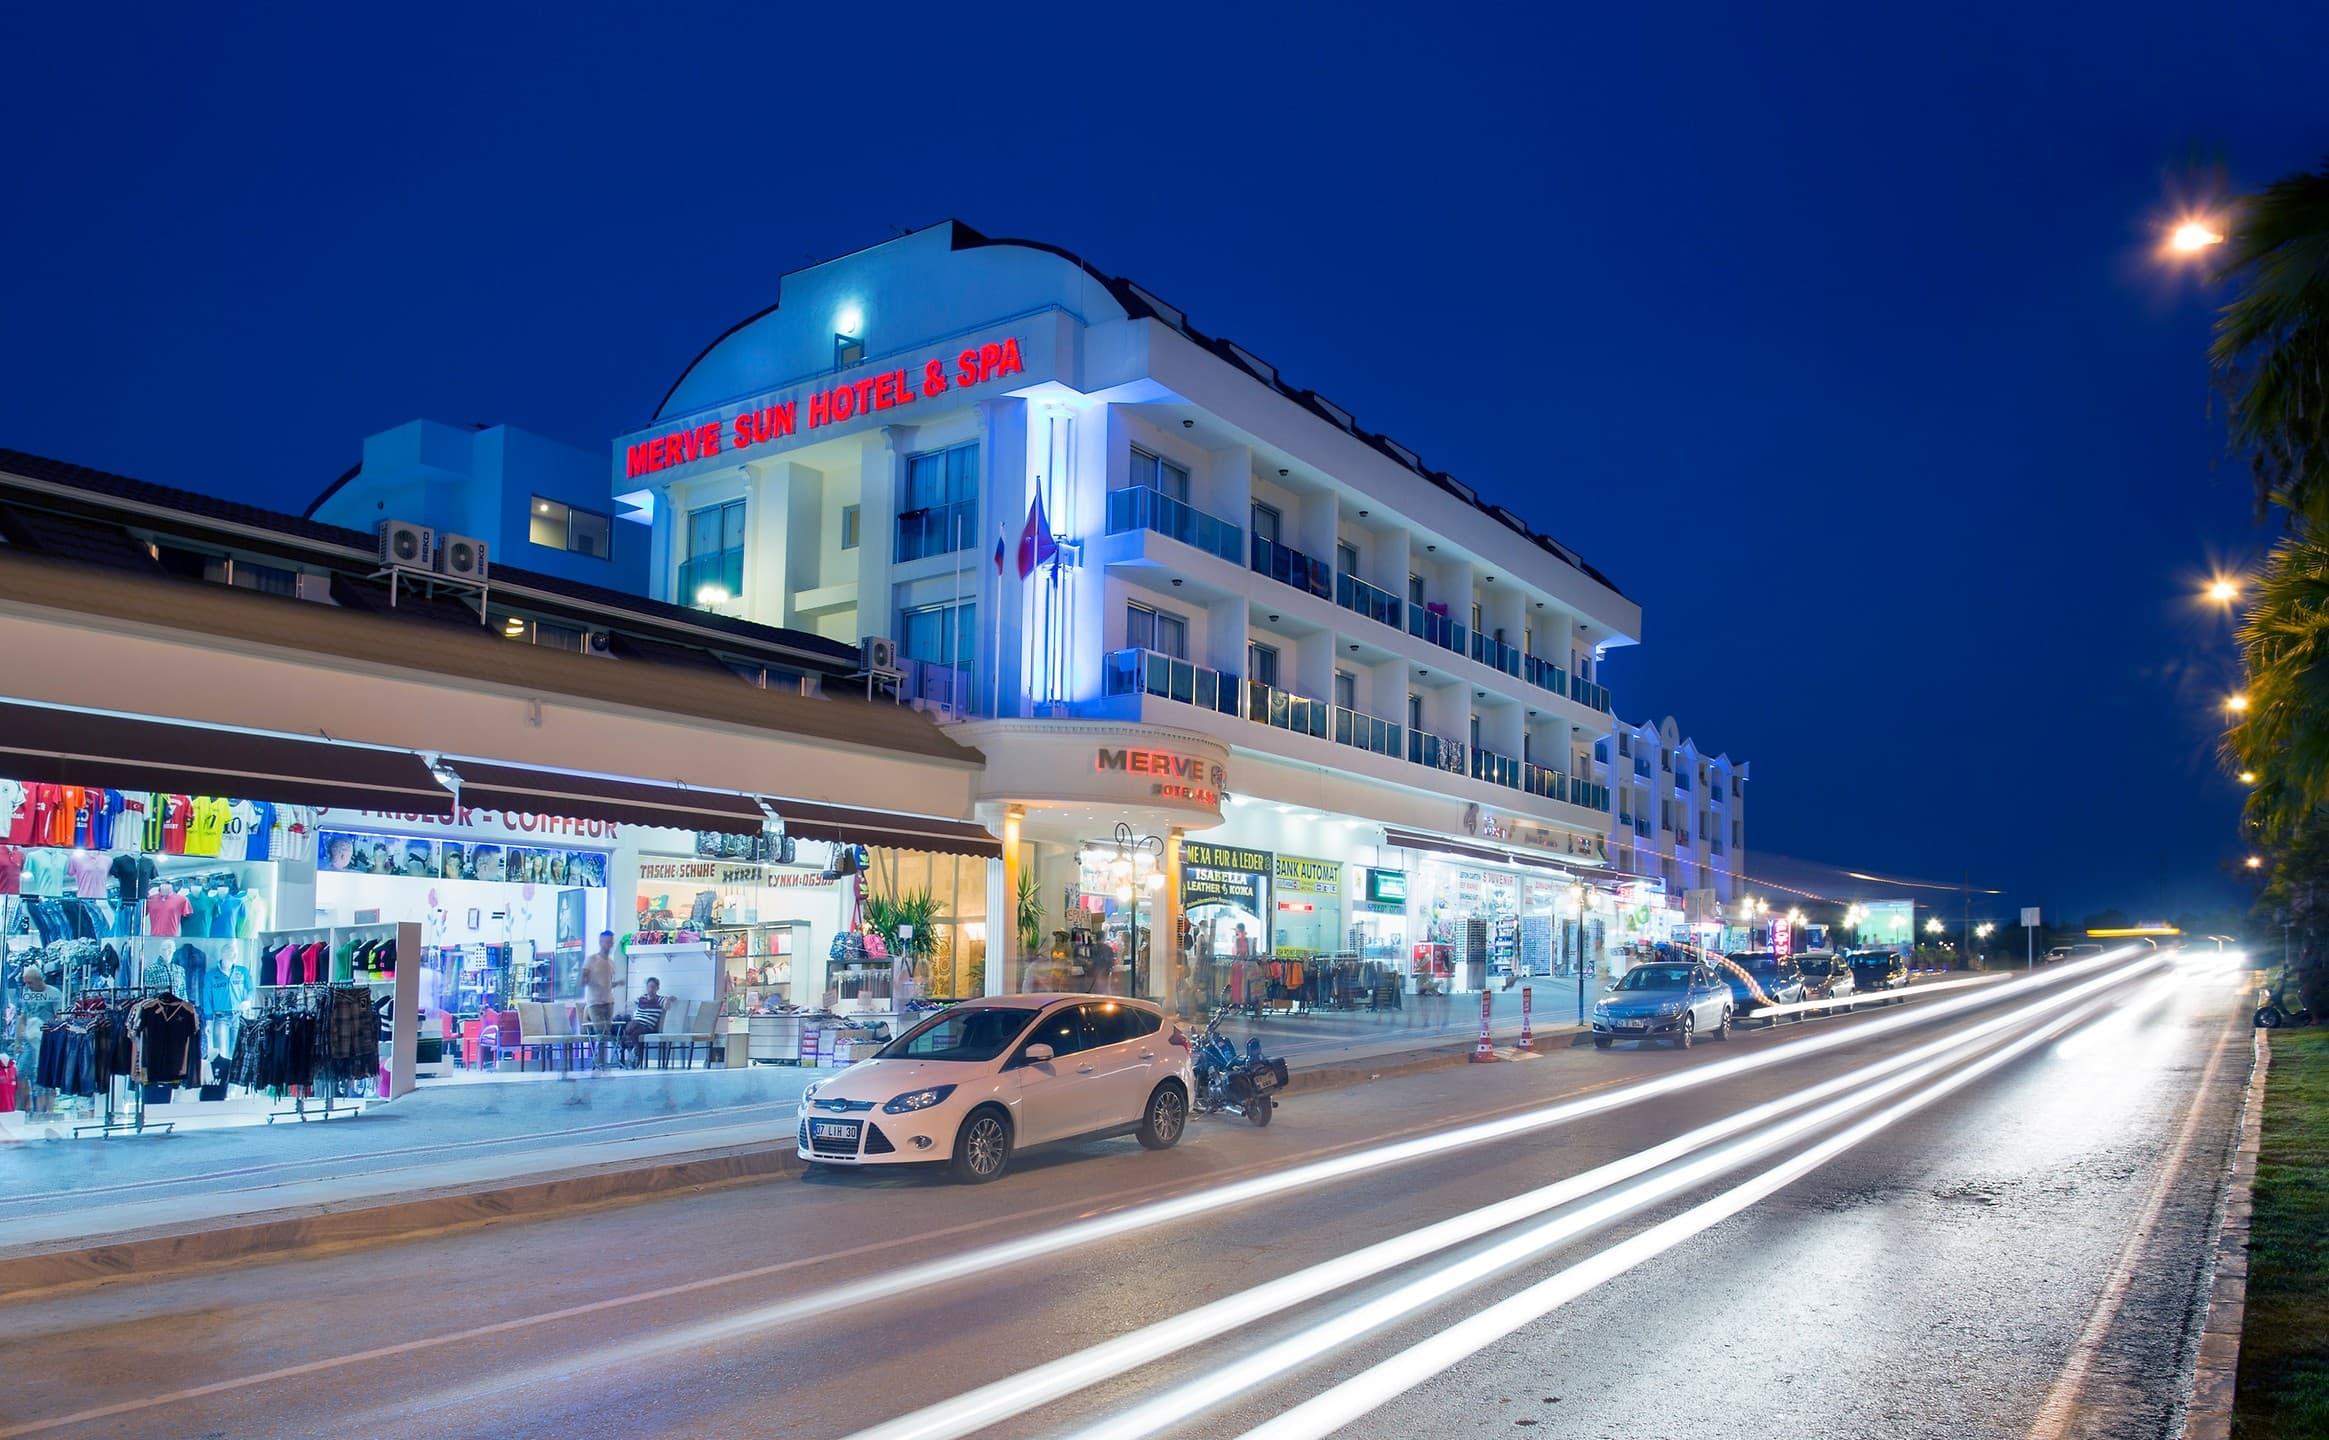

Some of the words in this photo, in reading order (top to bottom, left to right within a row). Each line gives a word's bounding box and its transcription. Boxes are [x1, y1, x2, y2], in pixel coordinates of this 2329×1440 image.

[625, 420, 722, 479] MERVE
[733, 400, 799, 450] SUN
[808, 368, 914, 430] HOTEL
[922, 358, 947, 397] &
[955, 336, 1024, 389] SPA
[1097, 748, 1205, 782] MERVE
[502, 809, 619, 840] COIFFEUR
[1214, 848, 1231, 868] FUR
[1239, 852, 1264, 872] LEDER
[1276, 859, 1299, 878] BANK
[1301, 863, 1339, 883] AUTOMAT
[1187, 881, 1221, 894] LEATHER
[1195, 868, 1248, 886] ISABELLA
[23, 991, 47, 1000] OPEN
[816, 1124, 825, 1135] 07
[846, 1127, 856, 1137] 30
